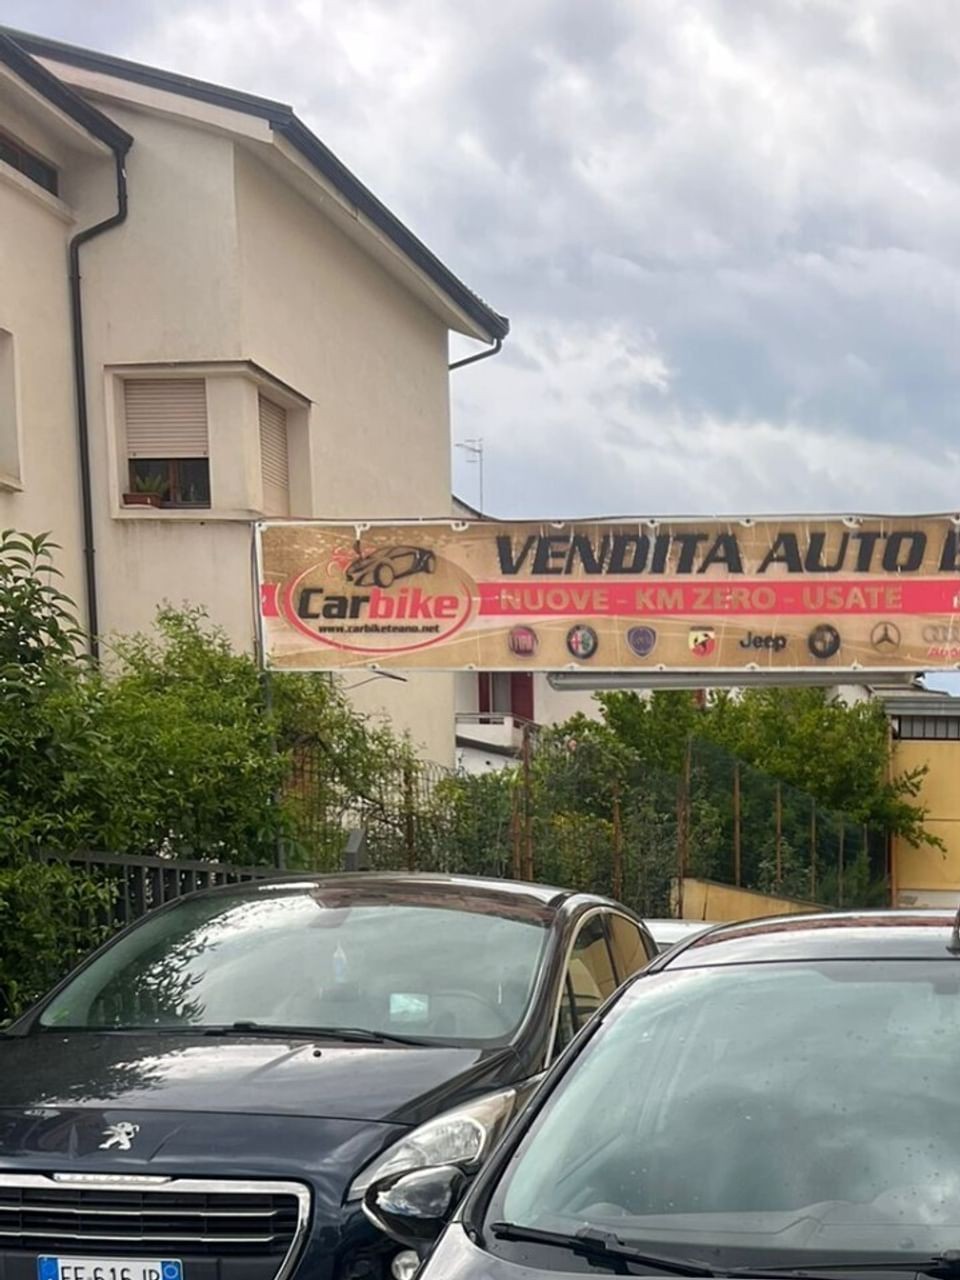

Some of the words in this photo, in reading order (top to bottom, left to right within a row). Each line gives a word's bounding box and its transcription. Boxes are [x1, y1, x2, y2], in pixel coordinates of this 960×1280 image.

[496, 532, 745, 575] VENDITA
[756, 526, 927, 574] AUTO
[298, 586, 459, 620] Carbike
[500, 588, 609, 611] NUOVE
[634, 588, 685, 610] KM
[692, 586, 777, 610] ZERO
[803, 586, 903, 609] USATE
[318, 623, 440, 634] www.carbiketeano.net
[739, 631, 788, 651] Jeep
